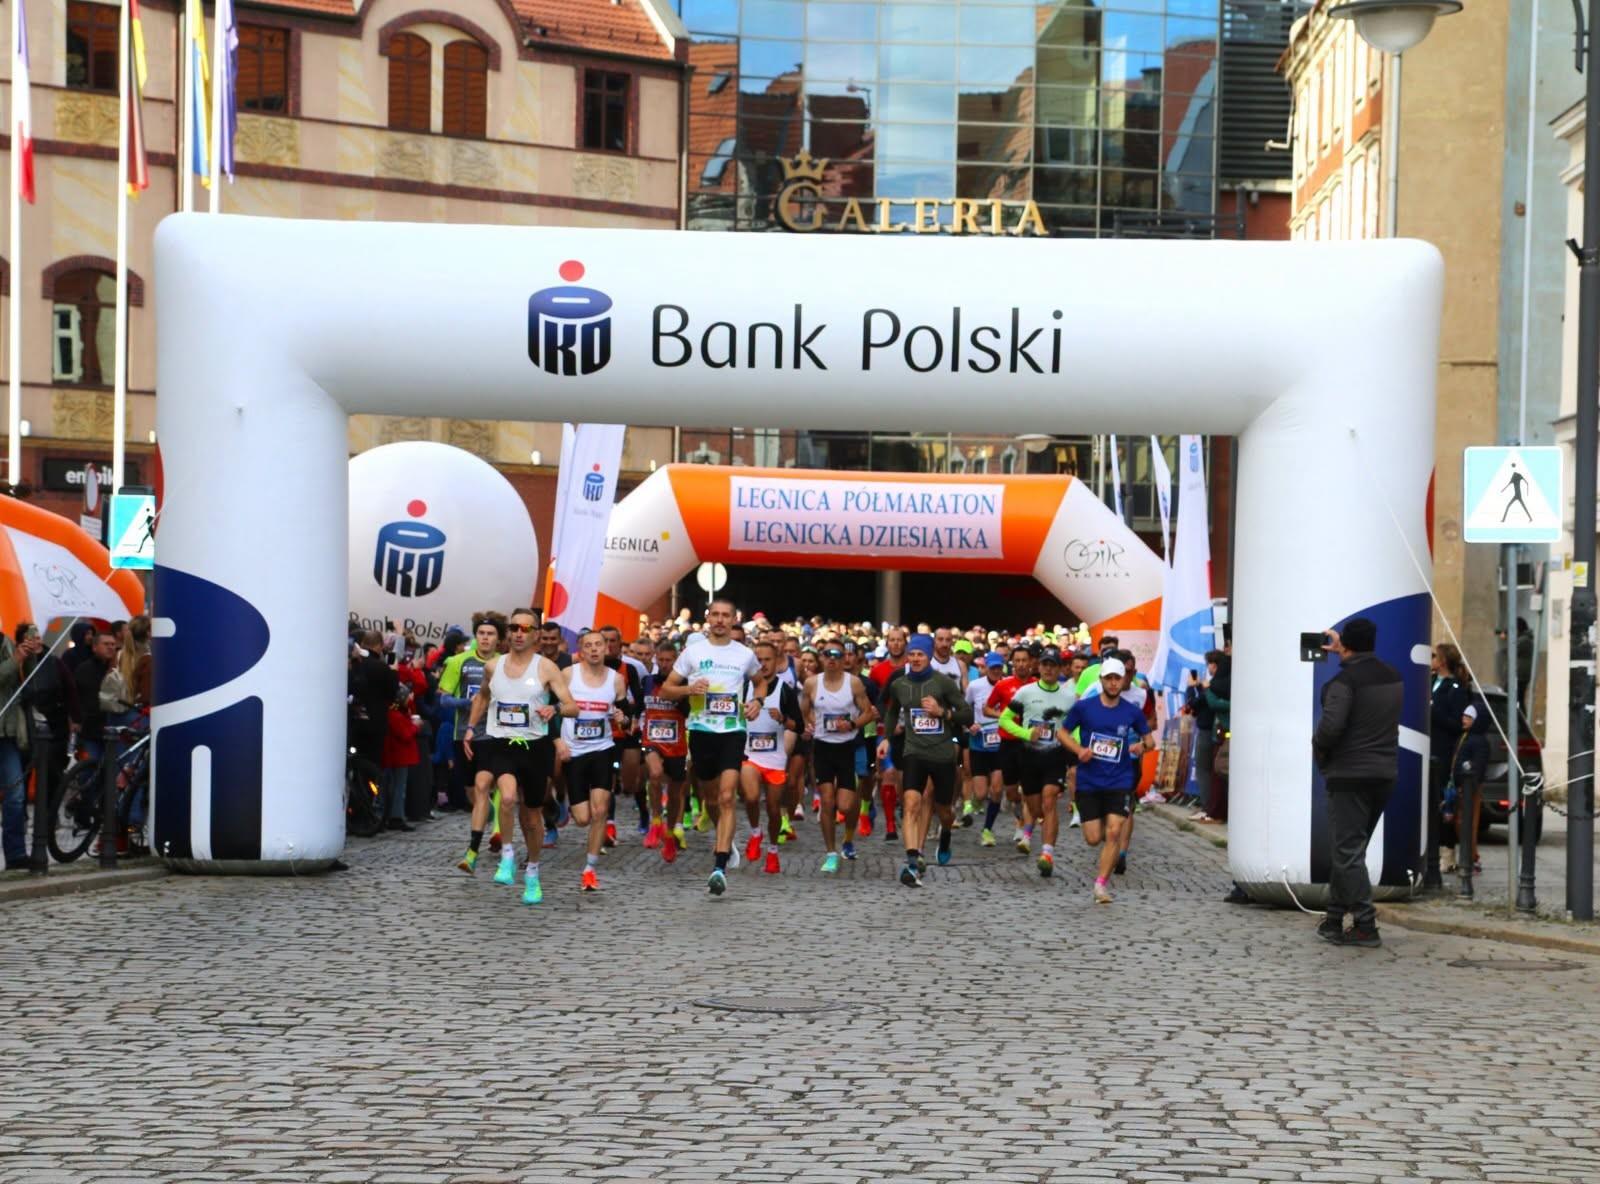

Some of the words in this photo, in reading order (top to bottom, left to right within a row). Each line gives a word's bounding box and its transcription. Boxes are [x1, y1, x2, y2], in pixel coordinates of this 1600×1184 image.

[777, 183, 1048, 235] GALERIA
[651, 303, 828, 371] Bank
[862, 306, 1063, 374] Polski
[737, 487, 831, 511] LEGNICA
[843, 486, 996, 516] PÓŁMARATON
[743, 520, 852, 546] LEGNICKA
[859, 524, 988, 554] DZIESIĄTKA
[604, 537, 659, 552] LEGNICA
[713, 702, 732, 711] 495
[918, 719, 936, 728] 640
[580, 727, 598, 736] 201
[654, 728, 671, 737] 674
[1096, 744, 1115, 755] 647
